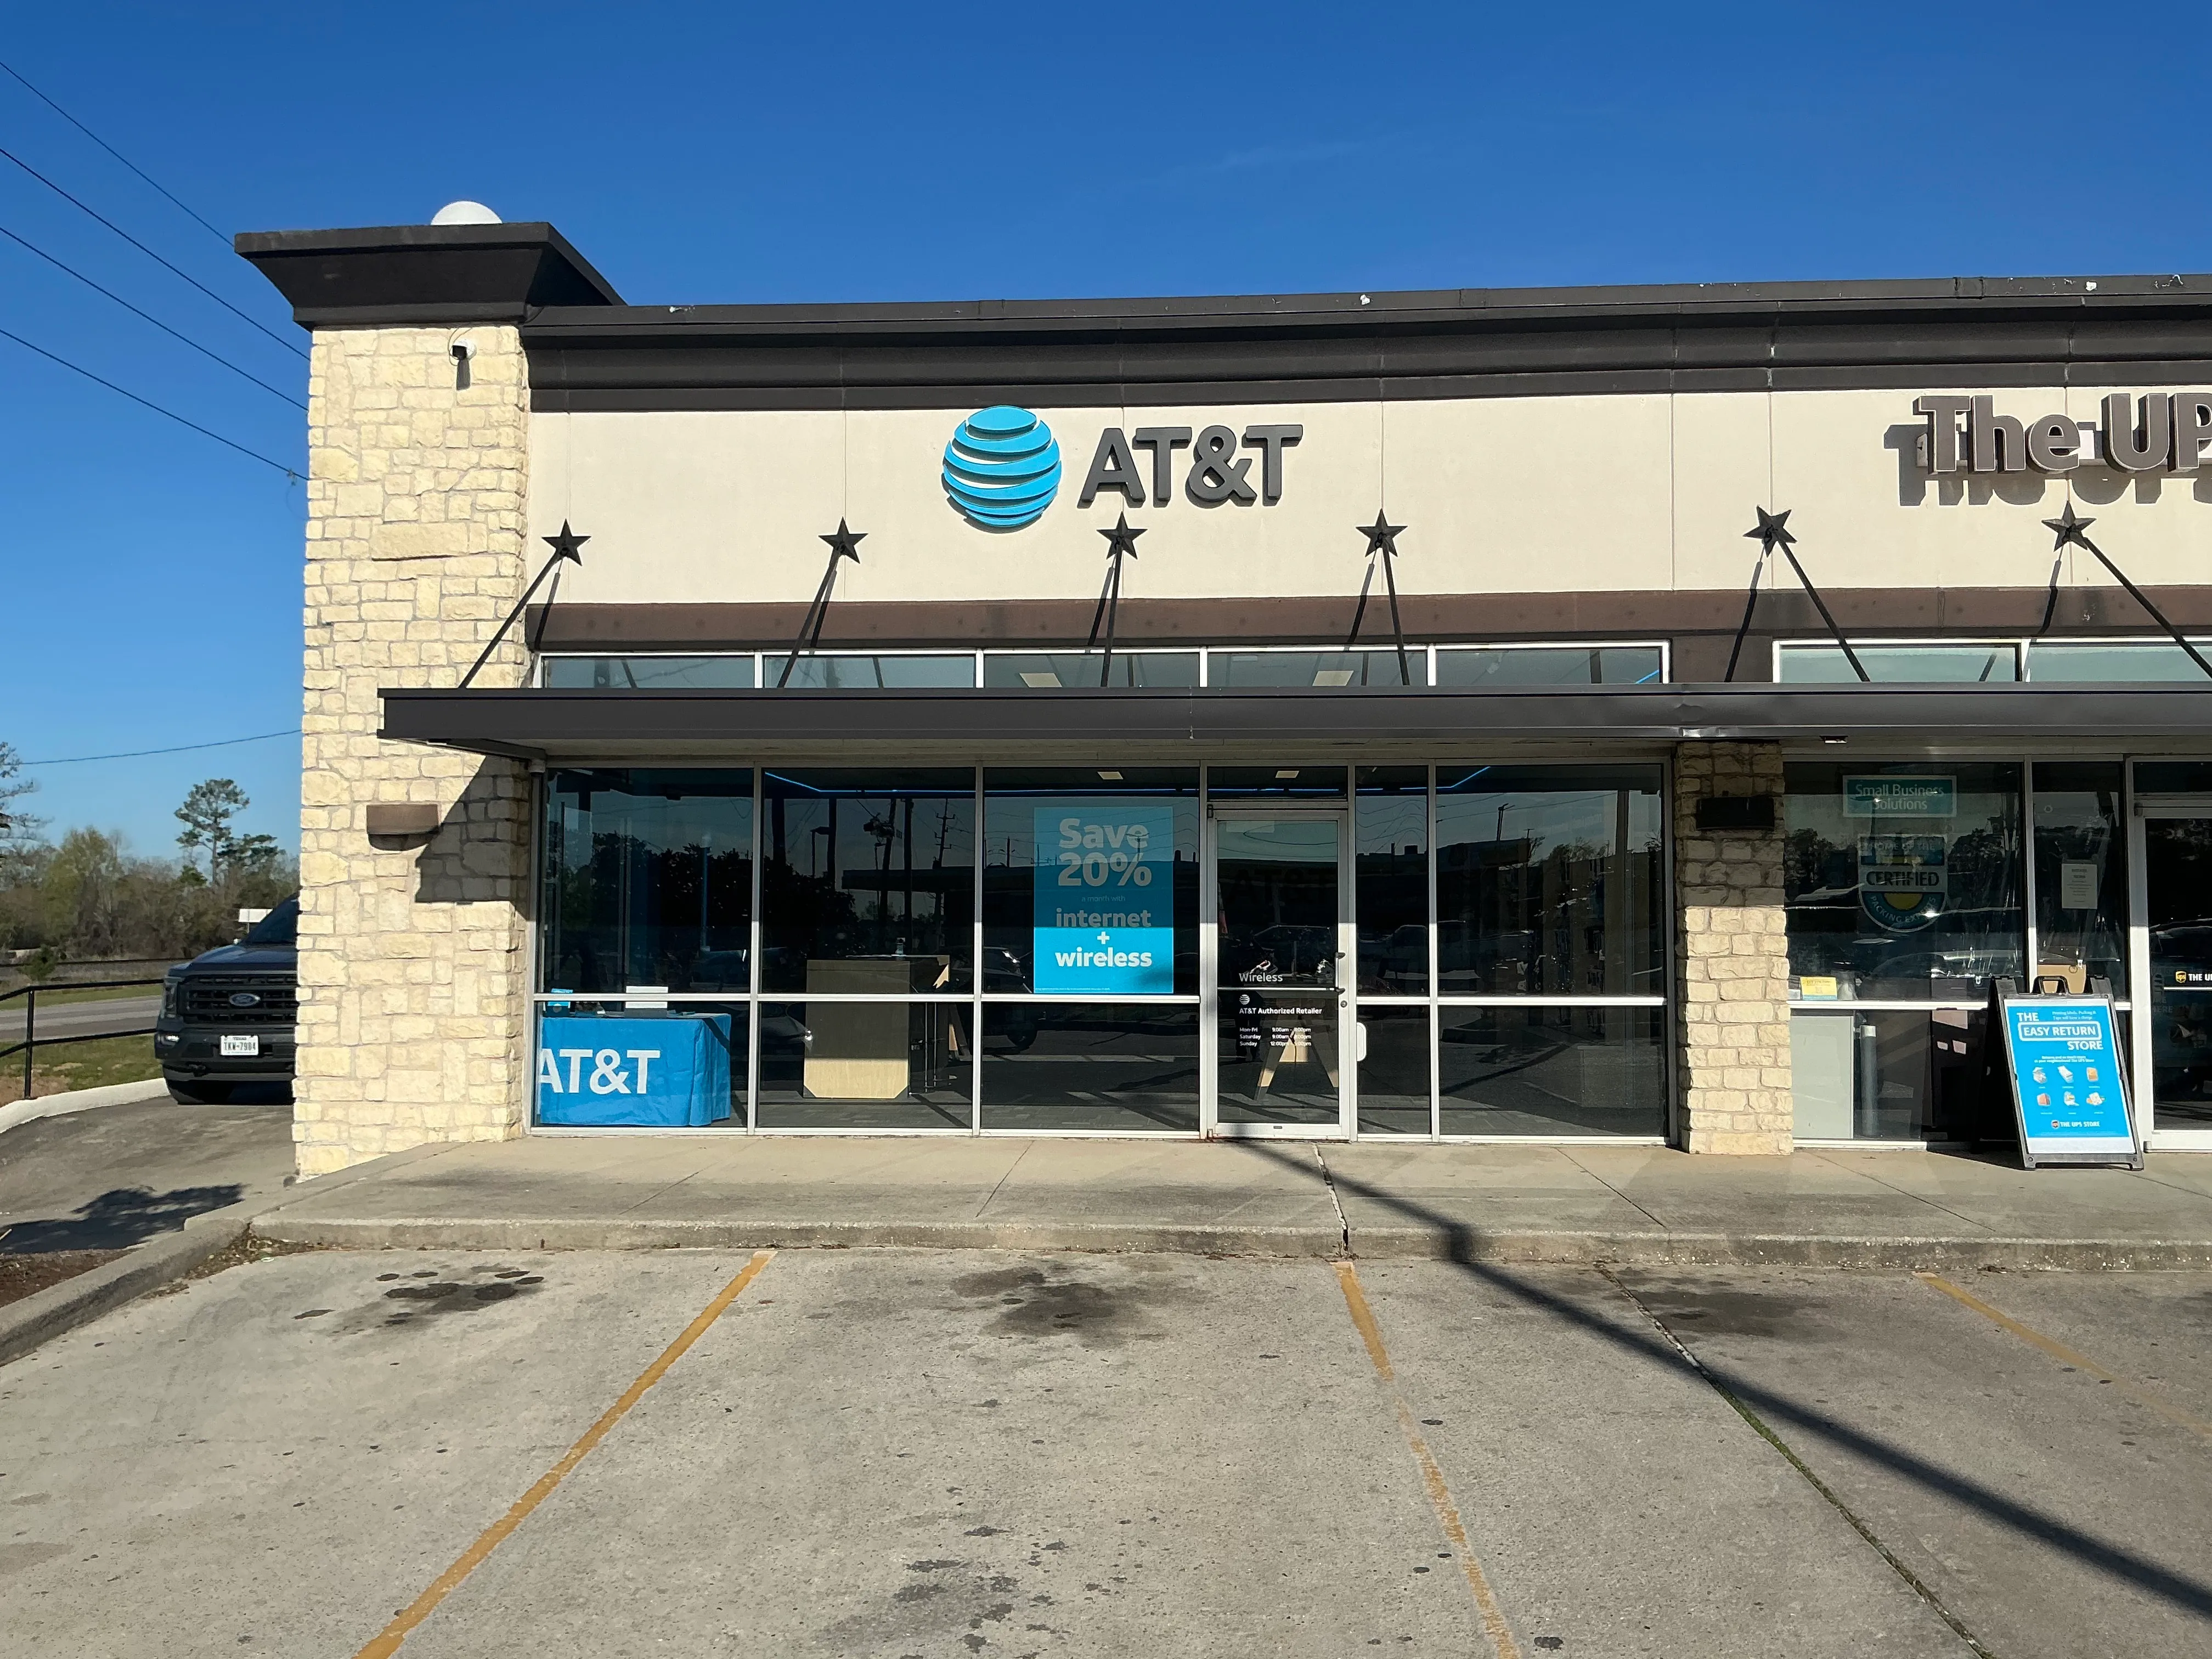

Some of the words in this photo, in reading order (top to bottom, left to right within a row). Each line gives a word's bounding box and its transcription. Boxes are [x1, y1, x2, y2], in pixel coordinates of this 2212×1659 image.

[1913, 394, 2081, 473] The
[1078, 425, 1304, 508] AT&T
[1855, 784, 1889, 796] Small
[1893, 784, 1944, 796] Business
[1874, 798, 1927, 810] Solutions
[1058, 817, 1149, 849] Save
[1058, 851, 1152, 887] 20%
[1866, 871, 1939, 887] CERTIFIED
[1056, 907, 1152, 927] internet
[1870, 896, 1901, 922] PACKING
[1097, 931, 1110, 944] +
[1055, 946, 1152, 967] wireless
[1239, 973, 1283, 982] Wireless
[2016, 1012, 2039, 1022] THE
[2023, 1026, 2050, 1036] EASY
[2052, 1026, 2096, 1036] RETURN
[2067, 1041, 2104, 1051] STORE
[539, 1048, 661, 1094] AT&T
